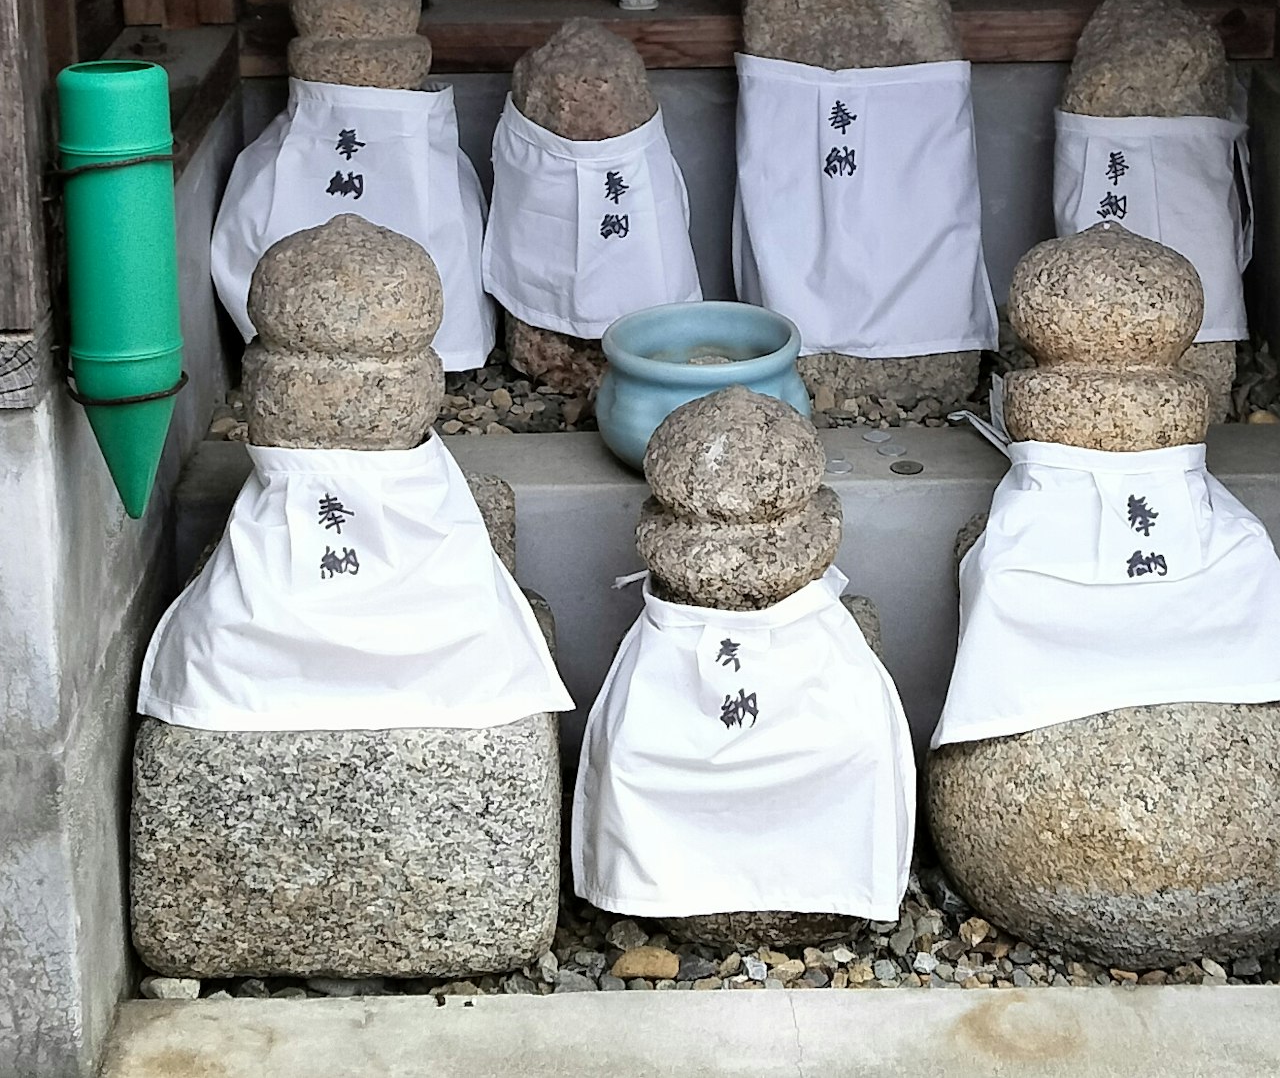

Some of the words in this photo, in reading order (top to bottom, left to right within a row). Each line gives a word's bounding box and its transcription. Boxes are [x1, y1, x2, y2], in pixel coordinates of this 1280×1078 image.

[324, 128, 367, 200] 奉納
[823, 100, 858, 179] 奉納
[599, 170, 630, 240] 奉納
[1096, 150, 1130, 220] 奉納
[317, 492, 360, 580] 奉納
[1125, 493, 1168, 578] 奉納
[714, 637, 760, 731] 奉納
